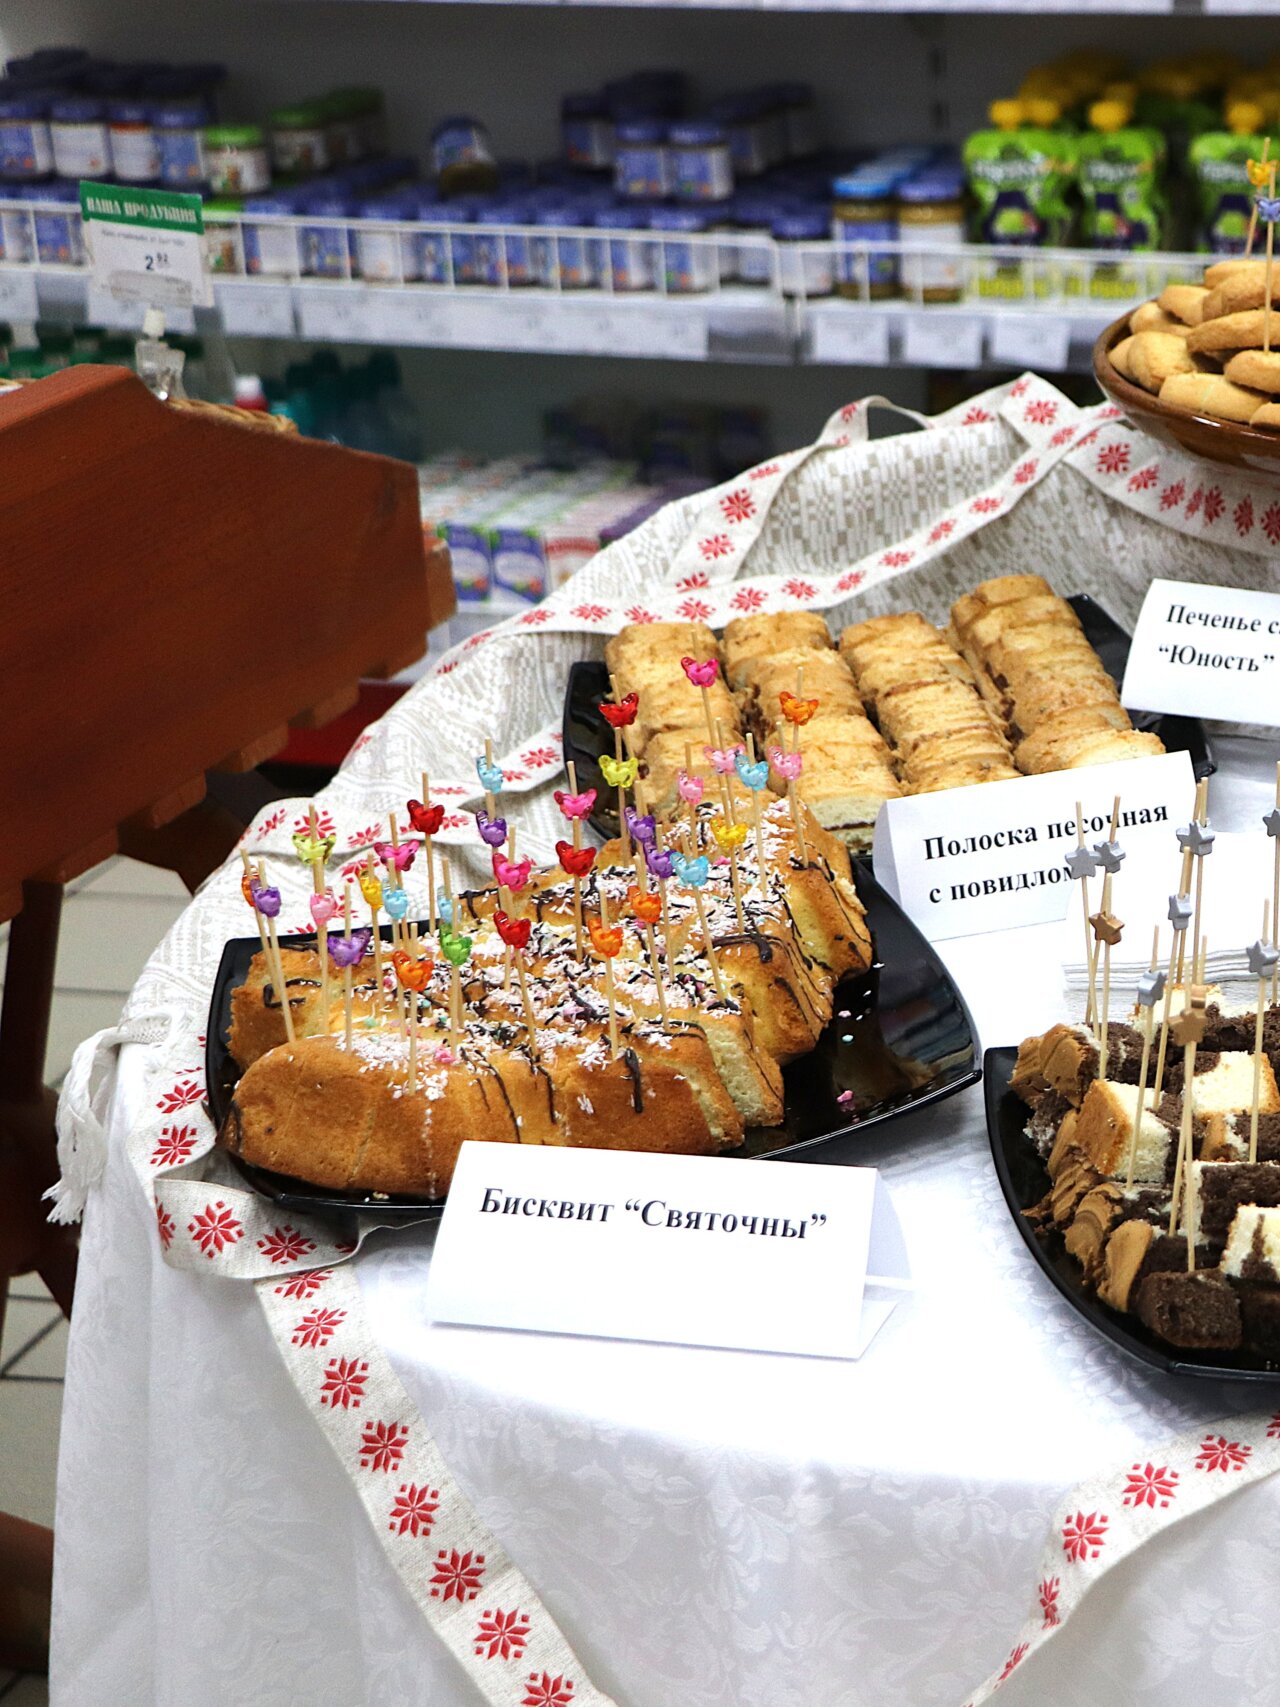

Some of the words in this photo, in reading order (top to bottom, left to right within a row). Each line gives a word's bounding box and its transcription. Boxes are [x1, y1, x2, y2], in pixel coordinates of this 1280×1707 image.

[1166, 603, 1261, 633] Печенье
[923, 825, 1039, 860] Полоска
[1047, 804, 1169, 840] песочная
[929, 887, 942, 905] с
[479, 1187, 614, 1223] Бисквит
